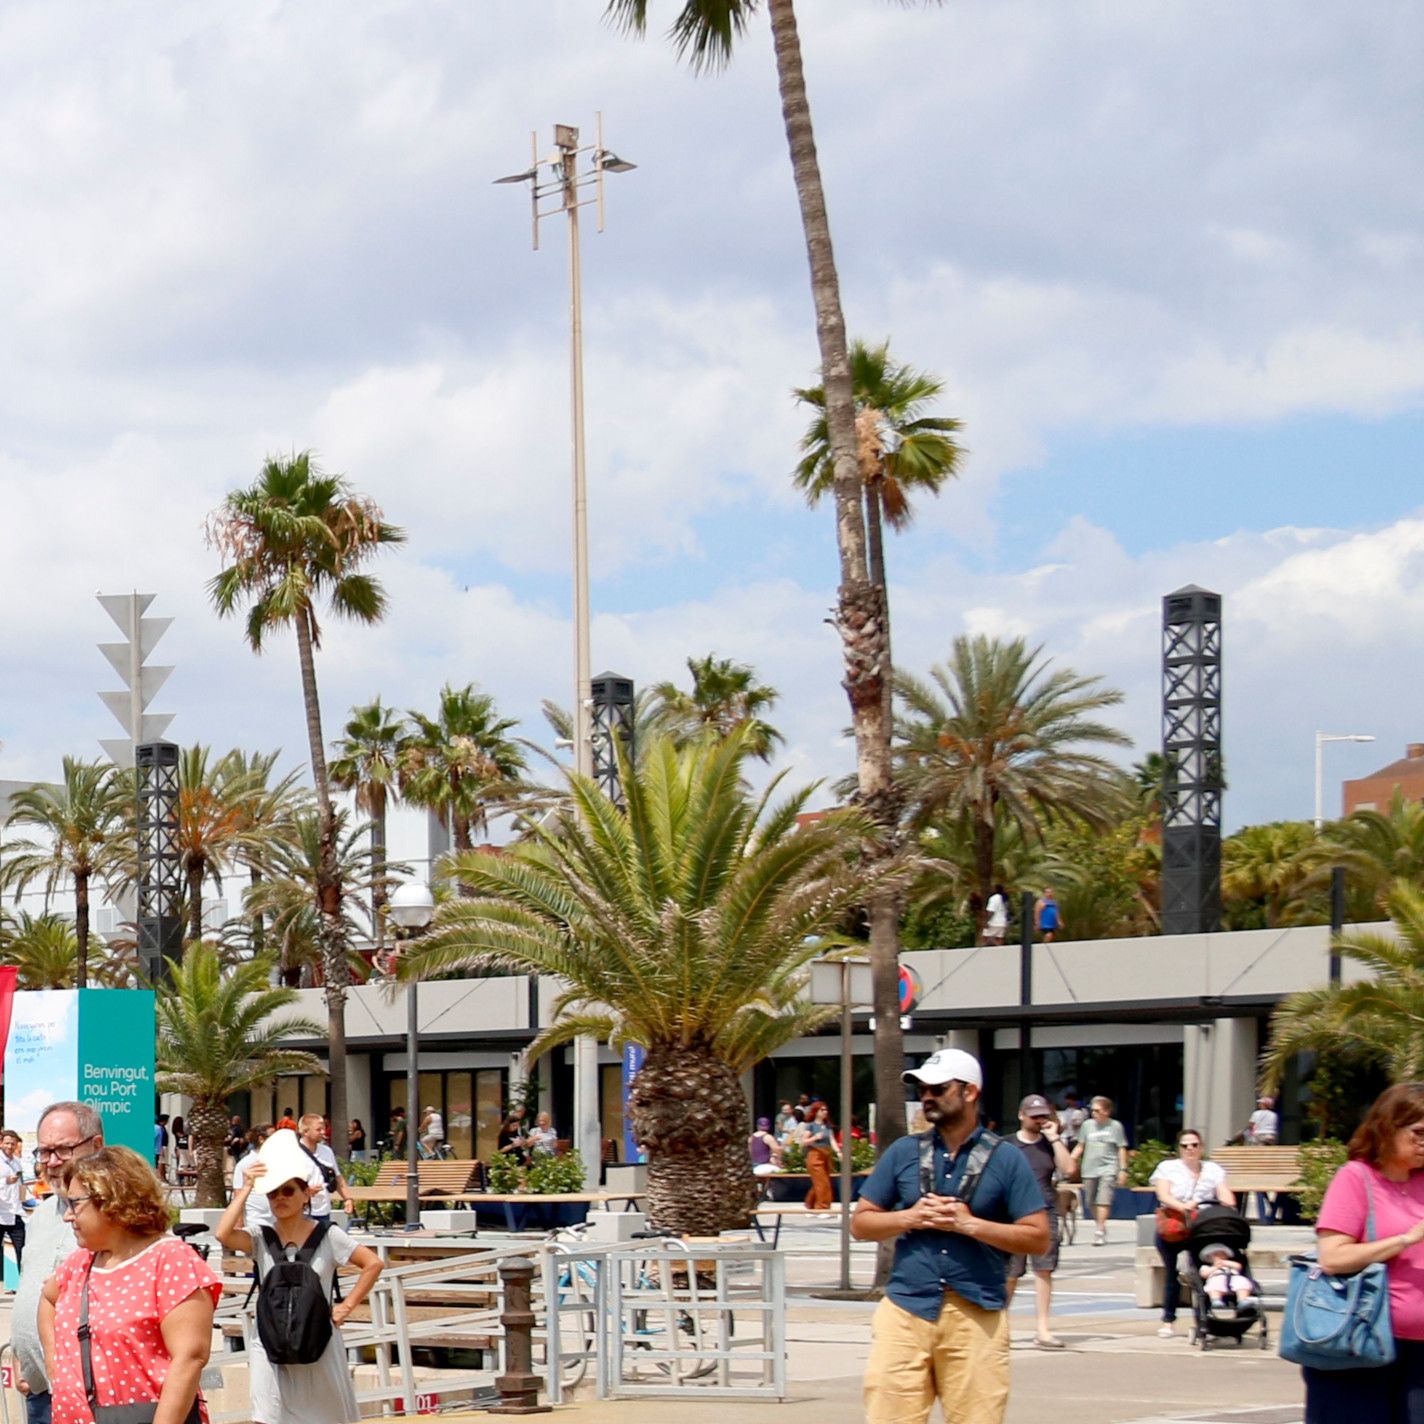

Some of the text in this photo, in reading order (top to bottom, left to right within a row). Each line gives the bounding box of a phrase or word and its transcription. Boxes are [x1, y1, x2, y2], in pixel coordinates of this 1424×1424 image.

[83, 1063, 149, 1083] Benvingut,
[83, 1080, 137, 1096] nou Port
